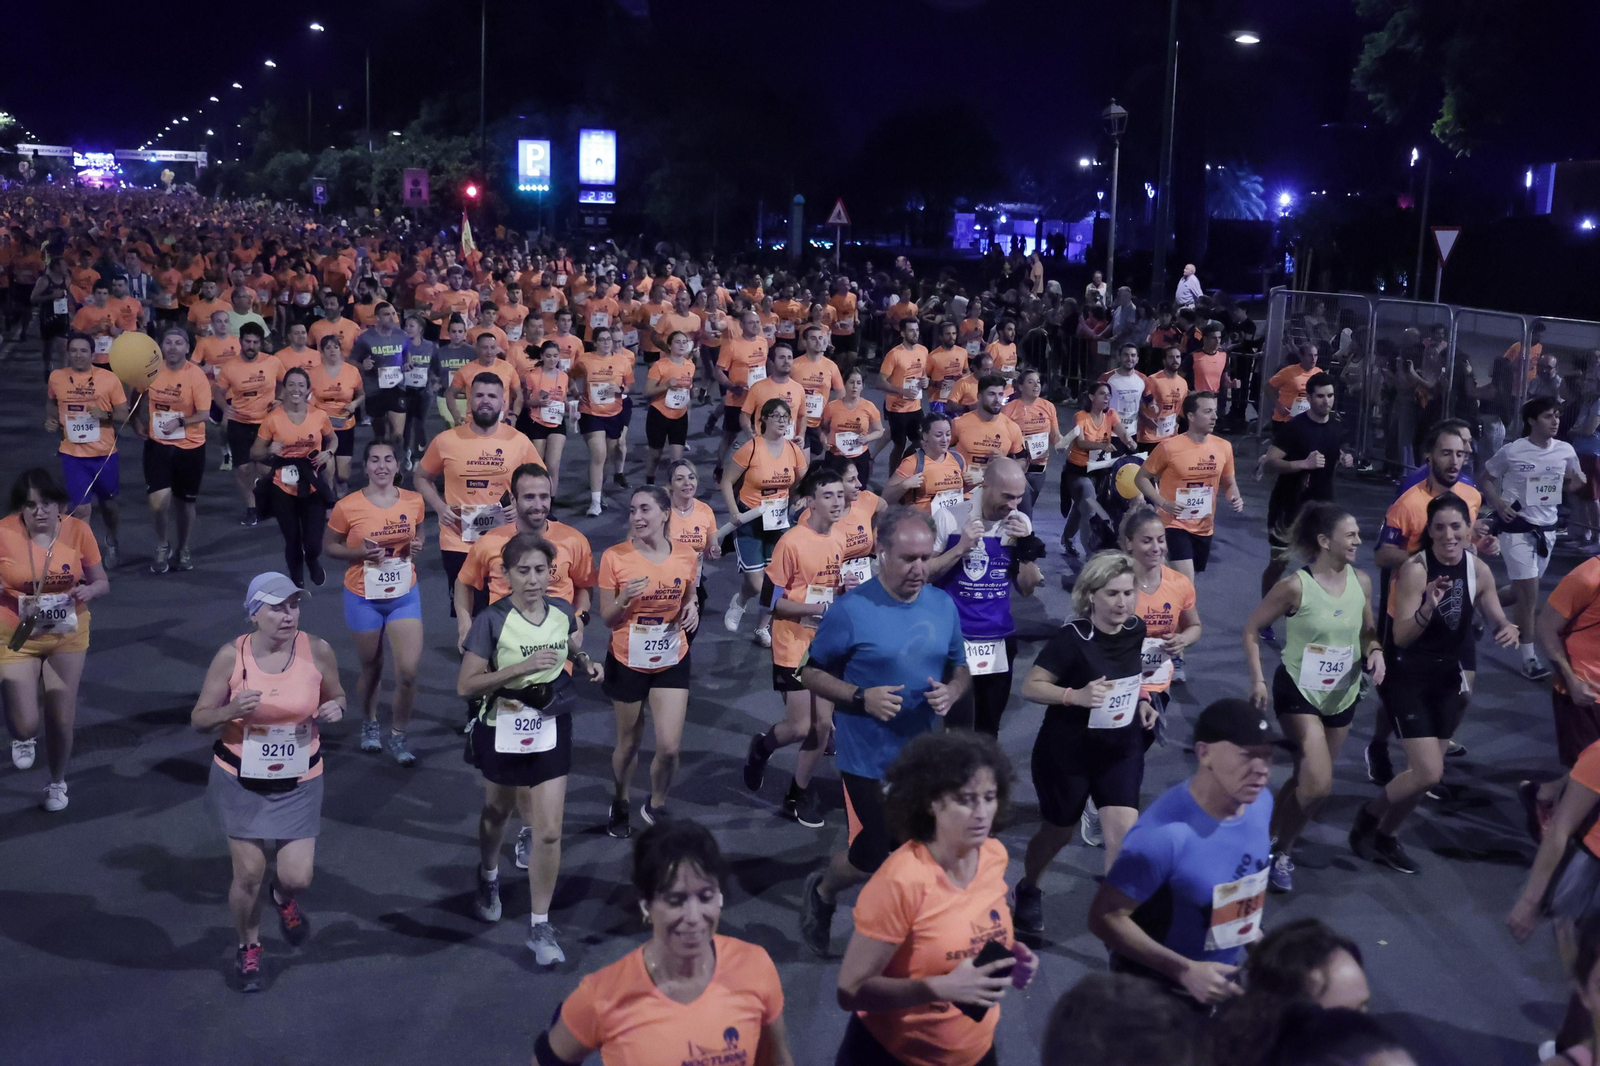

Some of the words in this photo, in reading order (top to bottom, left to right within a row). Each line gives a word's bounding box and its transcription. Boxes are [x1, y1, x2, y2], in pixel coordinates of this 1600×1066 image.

[526, 143, 545, 171] P
[1535, 485, 1557, 493] 14709
[383, 523, 410, 531] NOCTURNA
[473, 516, 495, 526] 4007
[378, 571, 401, 583] 4381
[39, 608, 67, 620] 1800
[644, 639, 670, 651] 2753
[967, 644, 995, 657] 11627
[1319, 660, 1344, 673] 7343
[1108, 693, 1132, 708] 2977
[514, 717, 543, 731] 9206
[262, 743, 295, 757] 9210
